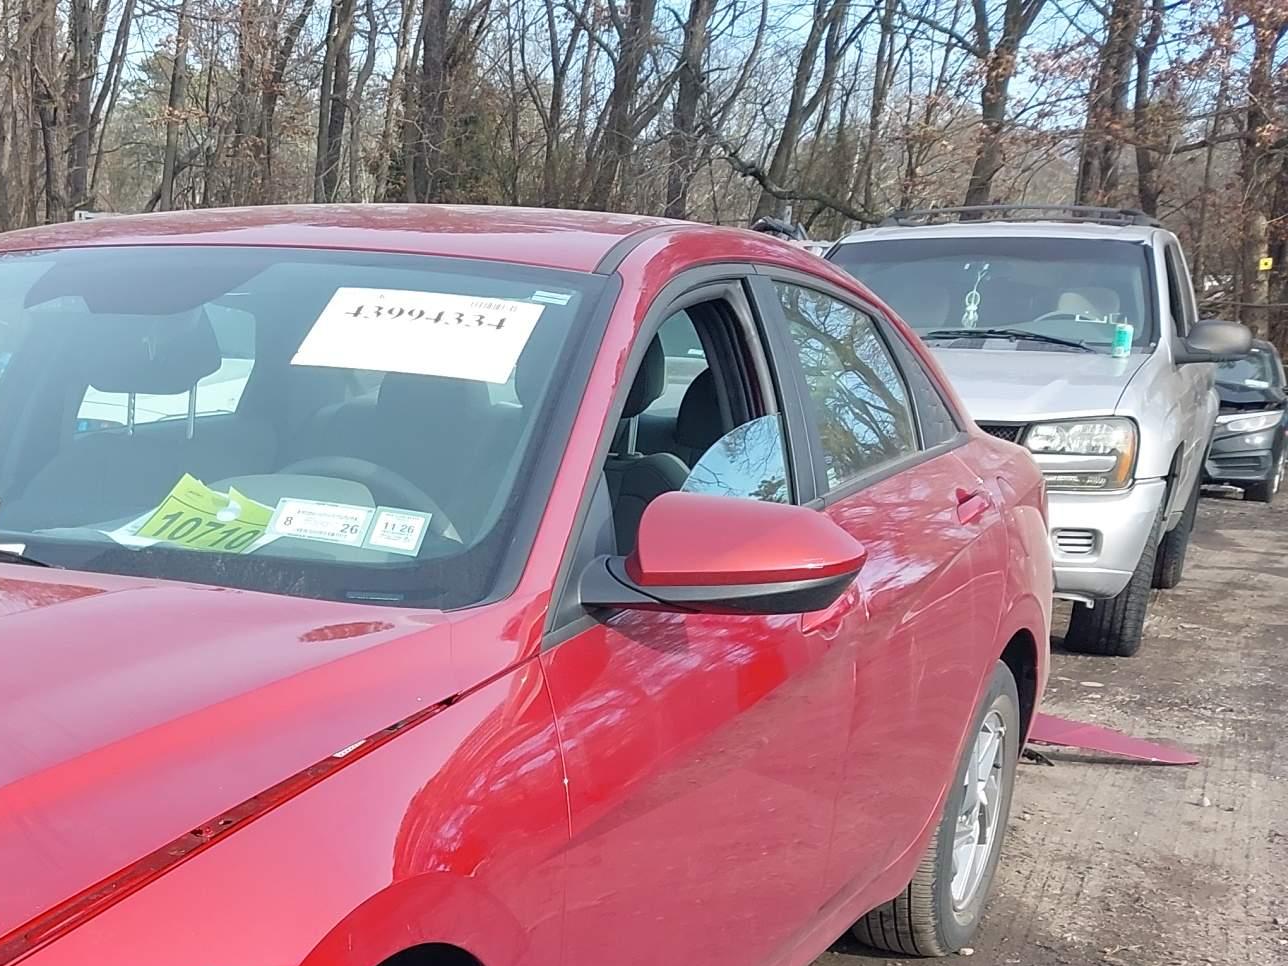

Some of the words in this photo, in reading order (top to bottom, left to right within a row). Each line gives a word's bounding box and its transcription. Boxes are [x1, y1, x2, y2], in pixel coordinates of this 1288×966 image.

[344, 304, 507, 331] 43994334
[283, 516, 294, 527] 8
[151, 511, 262, 550] 10710
[339, 523, 360, 535] 26
[399, 523, 416, 534] 26
